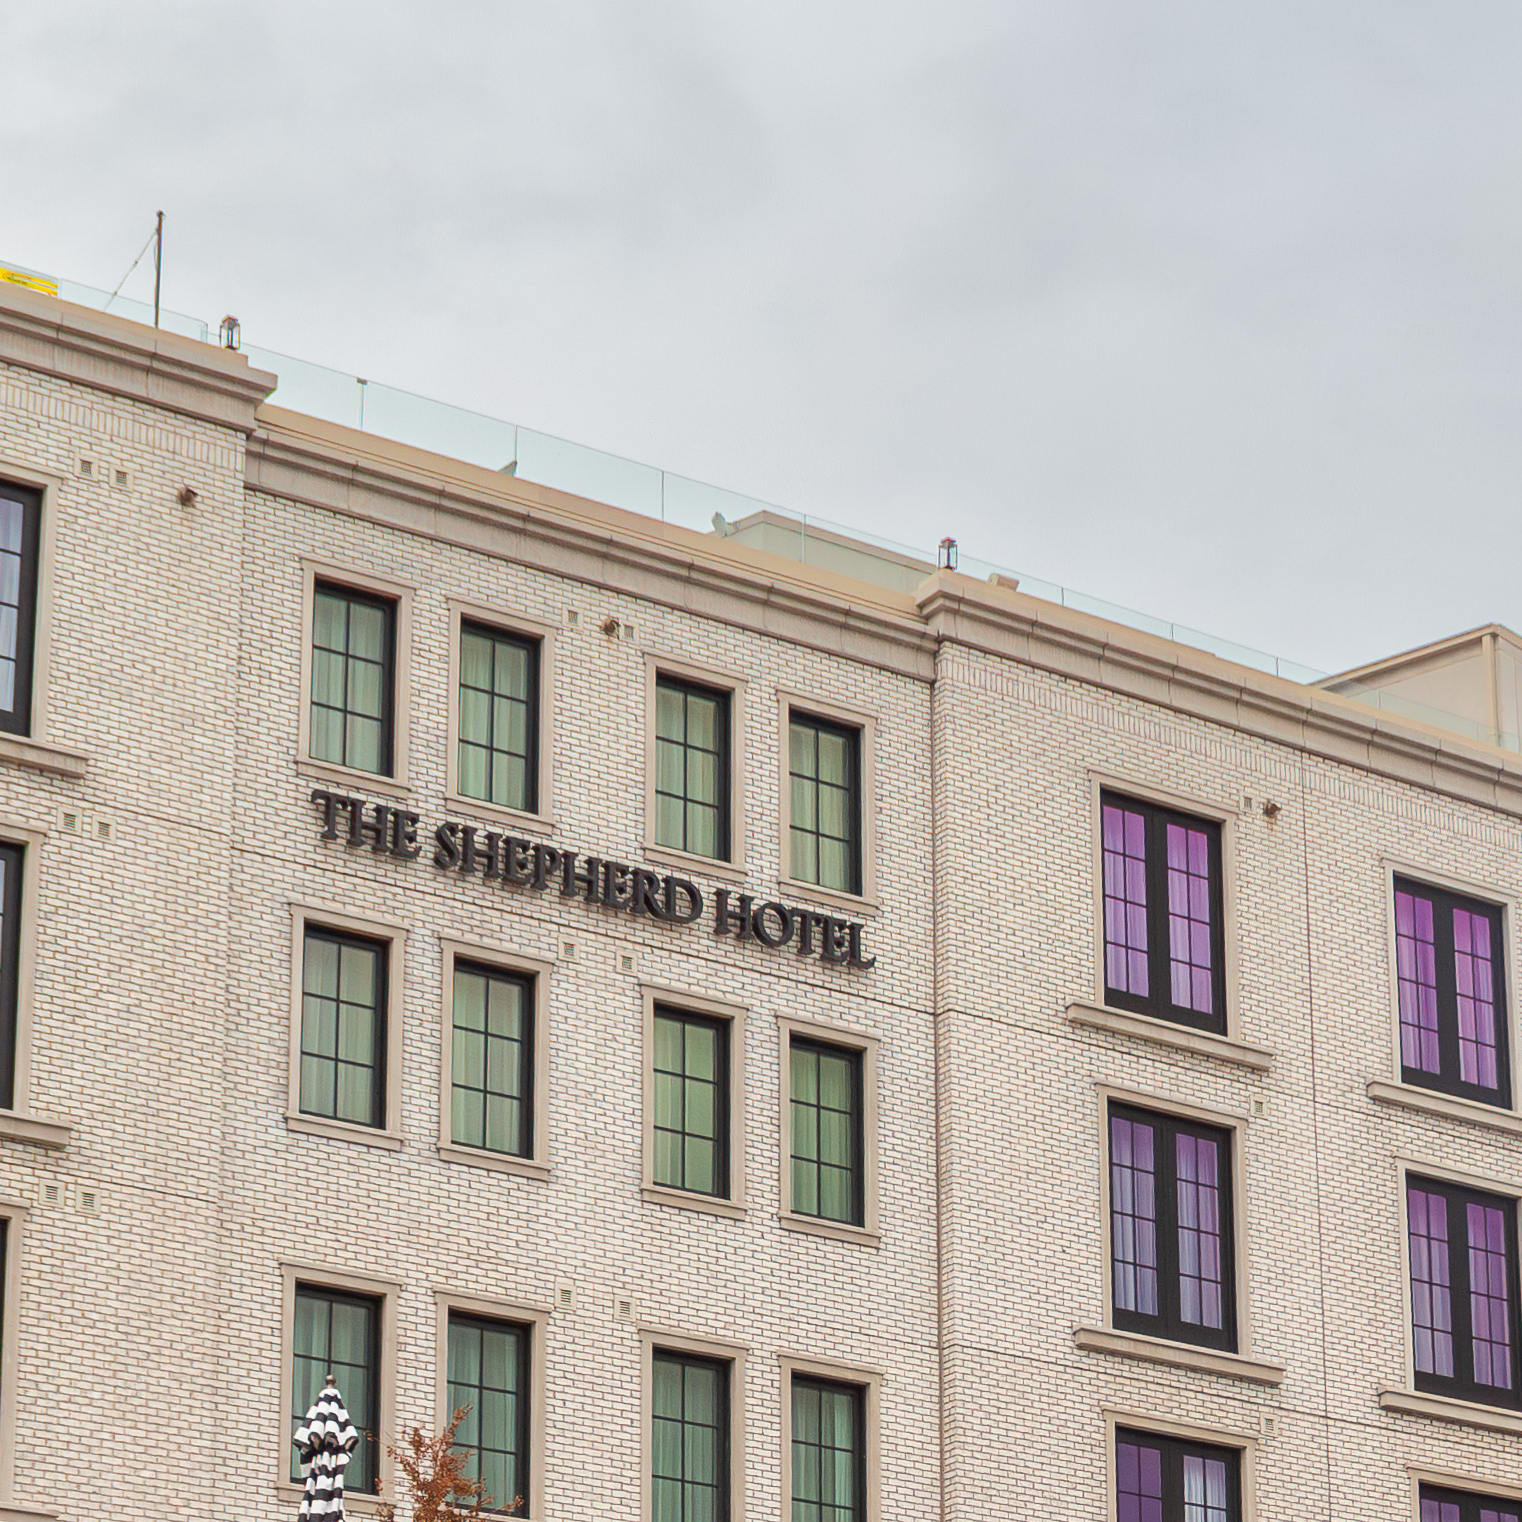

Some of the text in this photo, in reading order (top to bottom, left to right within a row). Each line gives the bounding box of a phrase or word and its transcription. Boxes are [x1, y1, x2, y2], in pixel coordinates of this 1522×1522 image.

[311, 788, 877, 970] THE SHEPHERD HOTEL
